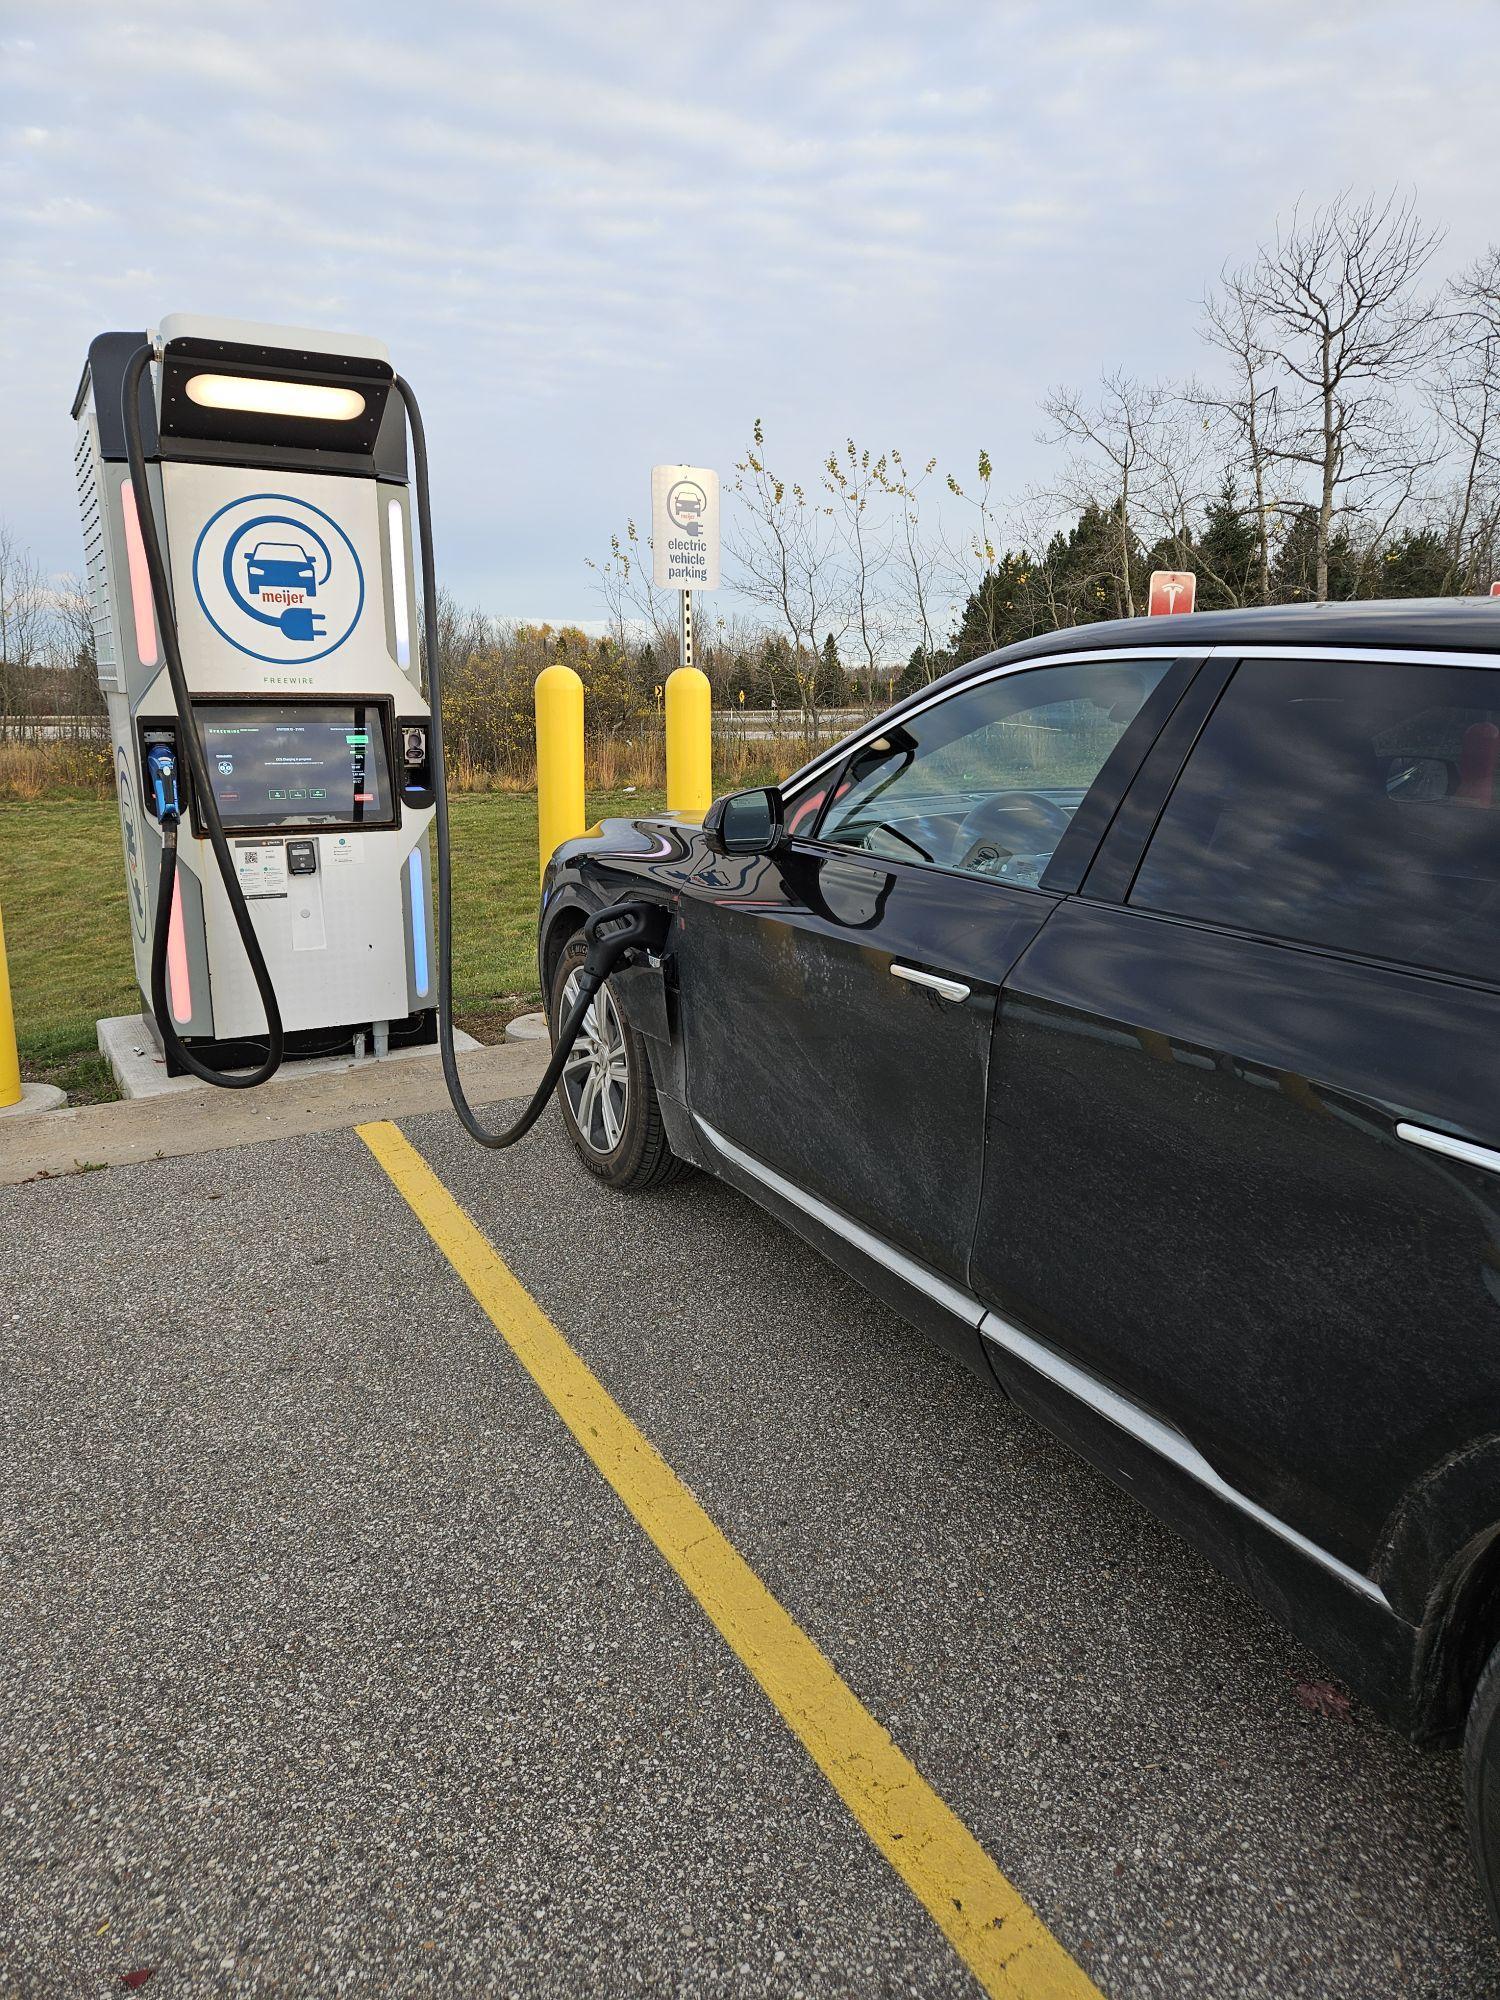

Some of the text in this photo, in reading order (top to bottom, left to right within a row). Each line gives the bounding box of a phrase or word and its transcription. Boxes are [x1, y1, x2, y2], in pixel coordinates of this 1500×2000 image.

[668, 538, 707, 552] electric
[670, 552, 704, 565] vehicle
[668, 566, 708, 581] parking
[262, 590, 304, 606] meijer
[263, 677, 314, 685] FREEWIRE
